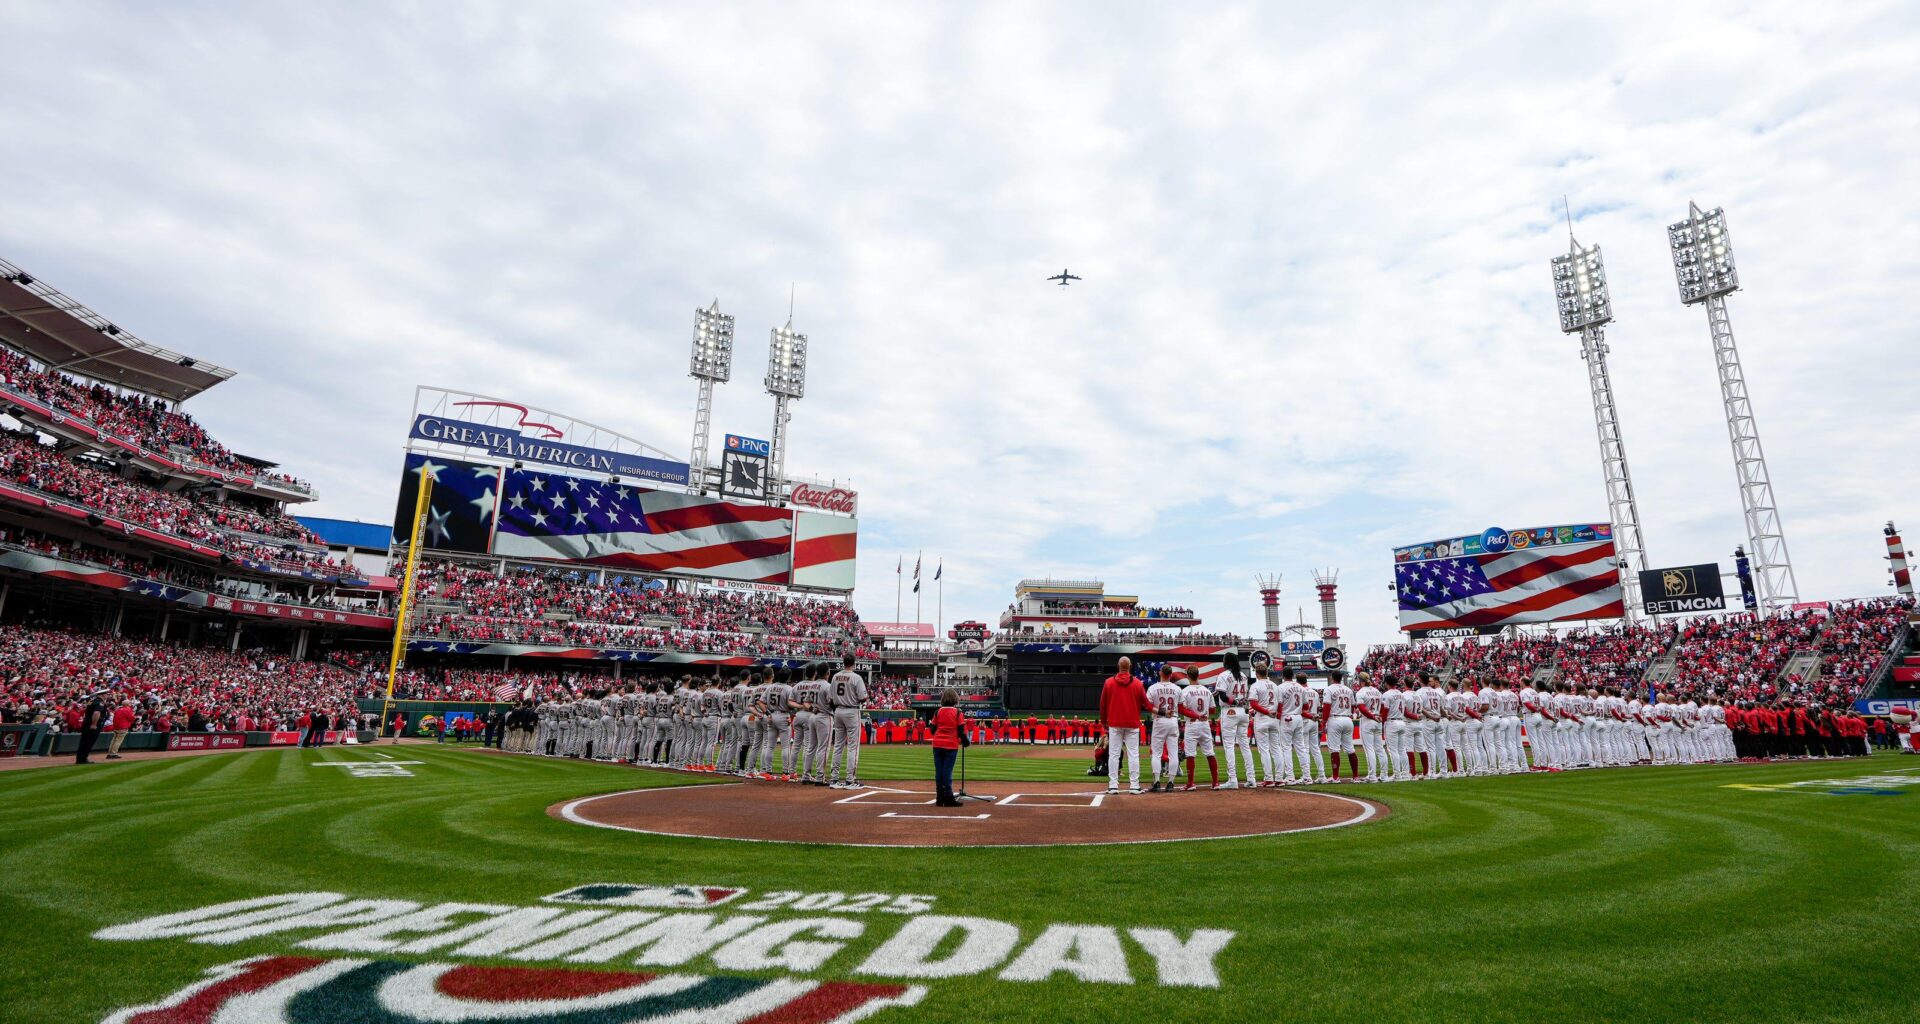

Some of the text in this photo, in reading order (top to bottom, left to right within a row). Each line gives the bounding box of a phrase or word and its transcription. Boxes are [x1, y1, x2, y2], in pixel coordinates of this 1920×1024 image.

[418, 418, 613, 472] GREAT AMERICAN
[741, 438, 768, 453] PNC
[619, 465, 685, 483] INSURANCE GROUP
[791, 483, 857, 513] Coca-Cola
[1486, 534, 1506, 546] P&G
[1512, 535, 1527, 546] Tide
[727, 581, 781, 593] TOYOTA TUNDRA
[1646, 596, 1723, 614] BETMGM
[1167, 610, 1193, 619] TriHealth
[873, 623, 919, 633] Reds
[1431, 627, 1475, 638] GRAVITY
[1296, 641, 1316, 650] PNC
[862, 663, 873, 671] PM
[836, 683, 845, 696] 6
[1232, 683, 1246, 696] 44
[770, 693, 781, 706] 51
[1158, 697, 1174, 711] 29
[1268, 691, 1275, 705] 2
[1294, 693, 1301, 707] 3
[1338, 696, 1350, 709] 33
[1370, 698, 1380, 711] 27
[1429, 698, 1438, 710] 15
[658, 703, 668, 713] 29
[1197, 698, 1205, 712] 9
[1398, 701, 1403, 713] 4
[1412, 702, 1421, 714] 12
[736, 889, 938, 915] 2025
[90, 890, 1238, 989] OPENING DAY
